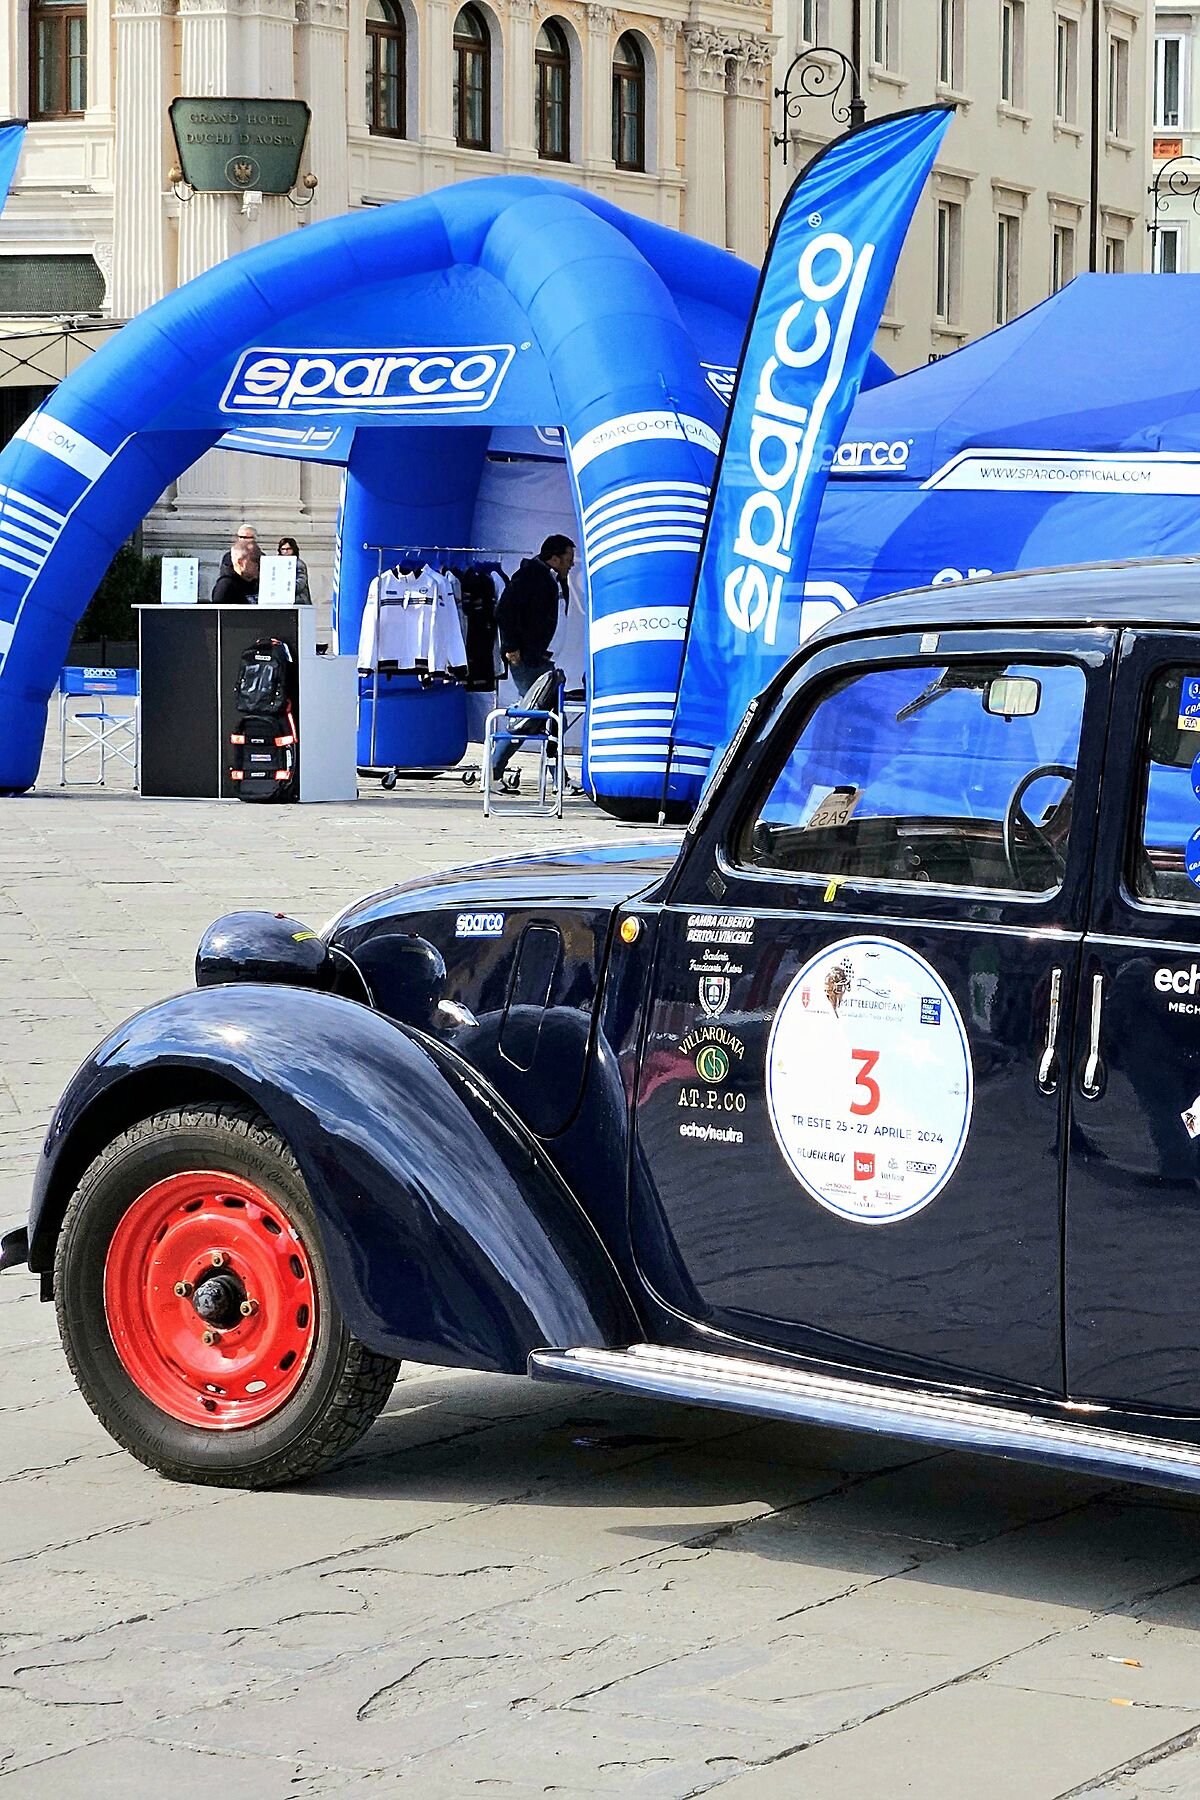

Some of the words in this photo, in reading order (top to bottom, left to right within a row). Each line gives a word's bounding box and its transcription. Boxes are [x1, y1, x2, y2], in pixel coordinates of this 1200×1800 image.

[190, 112, 239, 124] GRAND
[247, 113, 293, 127] HOTEL
[186, 133, 232, 145] DUCHI
[243, 354, 498, 409] sparco
[724, 232, 856, 634] sparco
[980, 466, 1151, 482] WWW.SPARCO-OFFICIAL.COM
[456, 914, 504, 935] sparco
[687, 914, 718, 927] GAMBA
[717, 915, 755, 929] ALBERTO
[687, 929, 719, 943] BERTOLI
[719, 930, 754, 944] VINCENT
[678, 1026, 745, 1060] VILL'ARQUATA
[849, 1048, 881, 1116] 3
[680, 1122, 744, 1143] echo/neutra
[791, 1114, 831, 1130] TRESTE
[836, 1120, 848, 1131] 25
[856, 1123, 868, 1134] 27
[874, 1126, 912, 1140] APRILE
[917, 1130, 944, 1143] 2024
